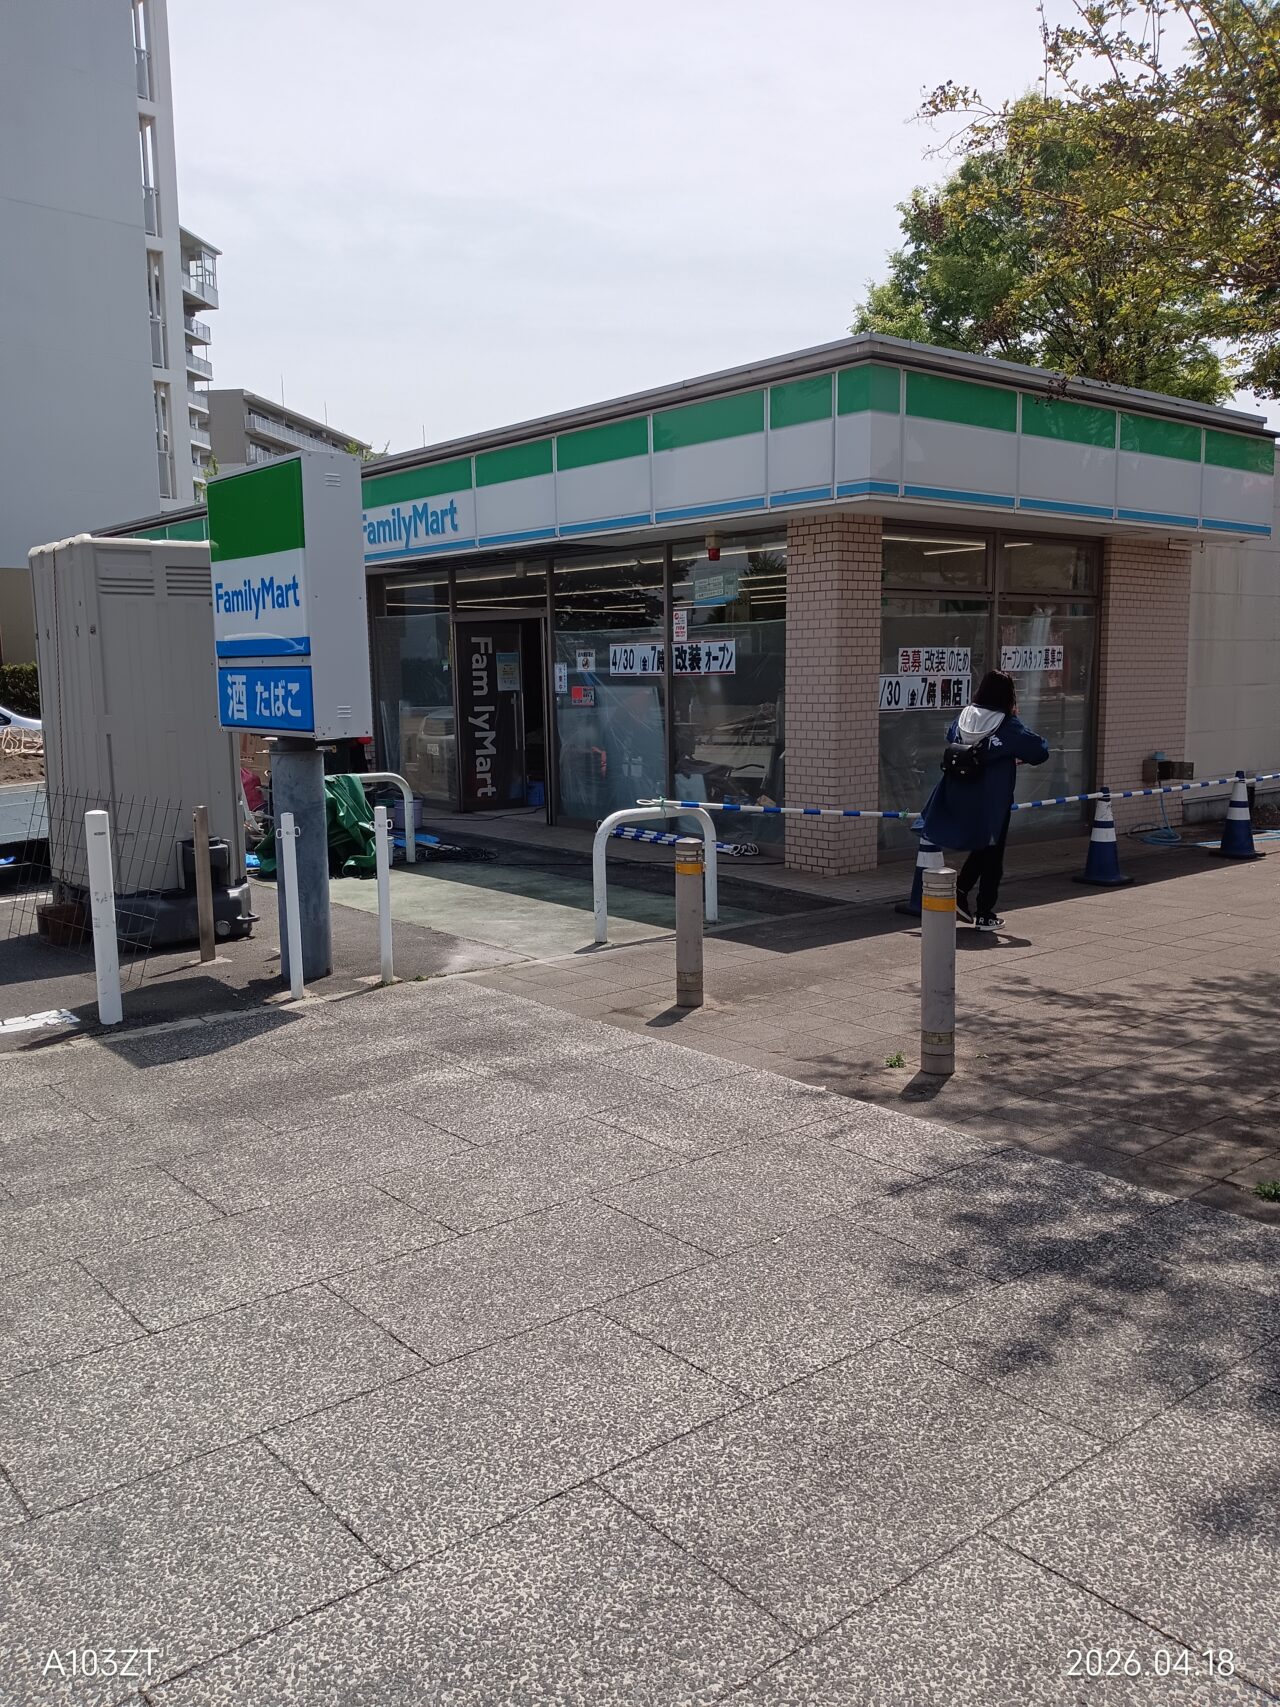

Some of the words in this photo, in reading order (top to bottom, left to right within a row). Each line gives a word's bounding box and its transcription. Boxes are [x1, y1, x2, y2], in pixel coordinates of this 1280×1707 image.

[214, 574, 300, 620] FamilyMart
[226, 673, 248, 721] 酒
[255, 679, 302, 718] たばこ
